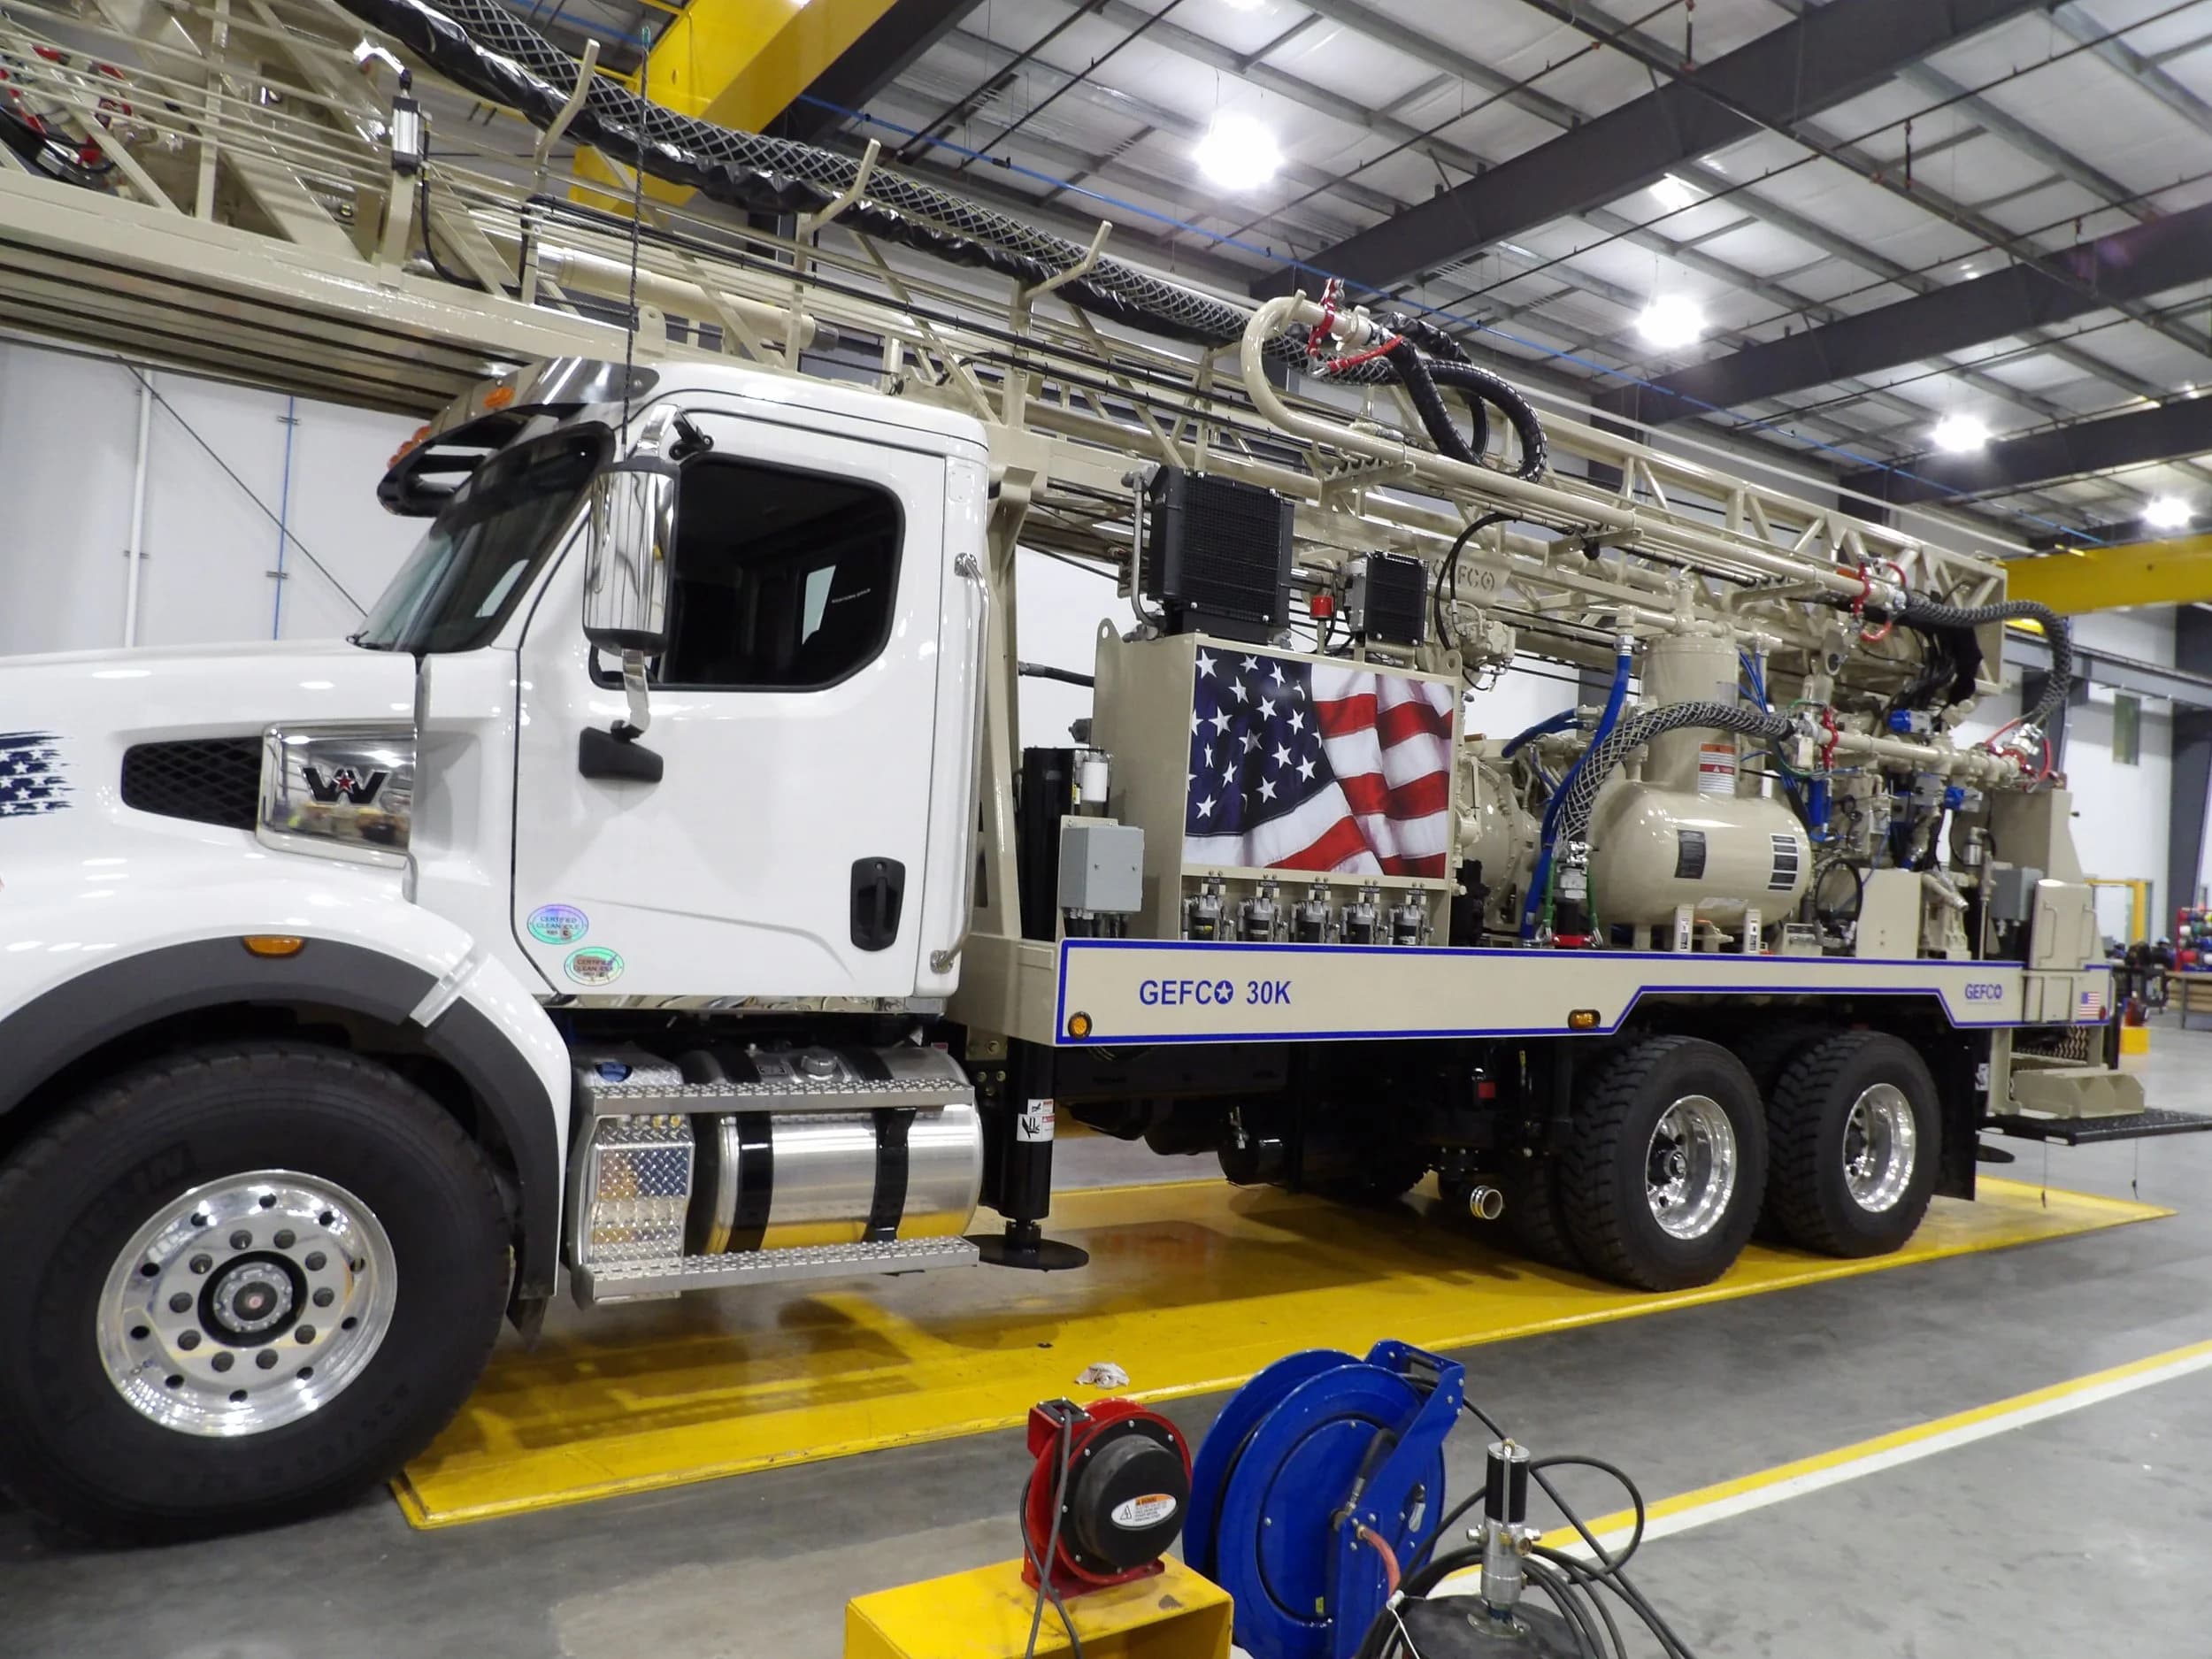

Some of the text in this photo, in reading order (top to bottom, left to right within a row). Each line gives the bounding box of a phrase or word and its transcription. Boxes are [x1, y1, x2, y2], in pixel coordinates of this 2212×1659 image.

[1432, 558, 1495, 591] GFCO
[1139, 979, 1292, 1005] GEFCO 30K
[1965, 983, 2001, 999] GEFCO
